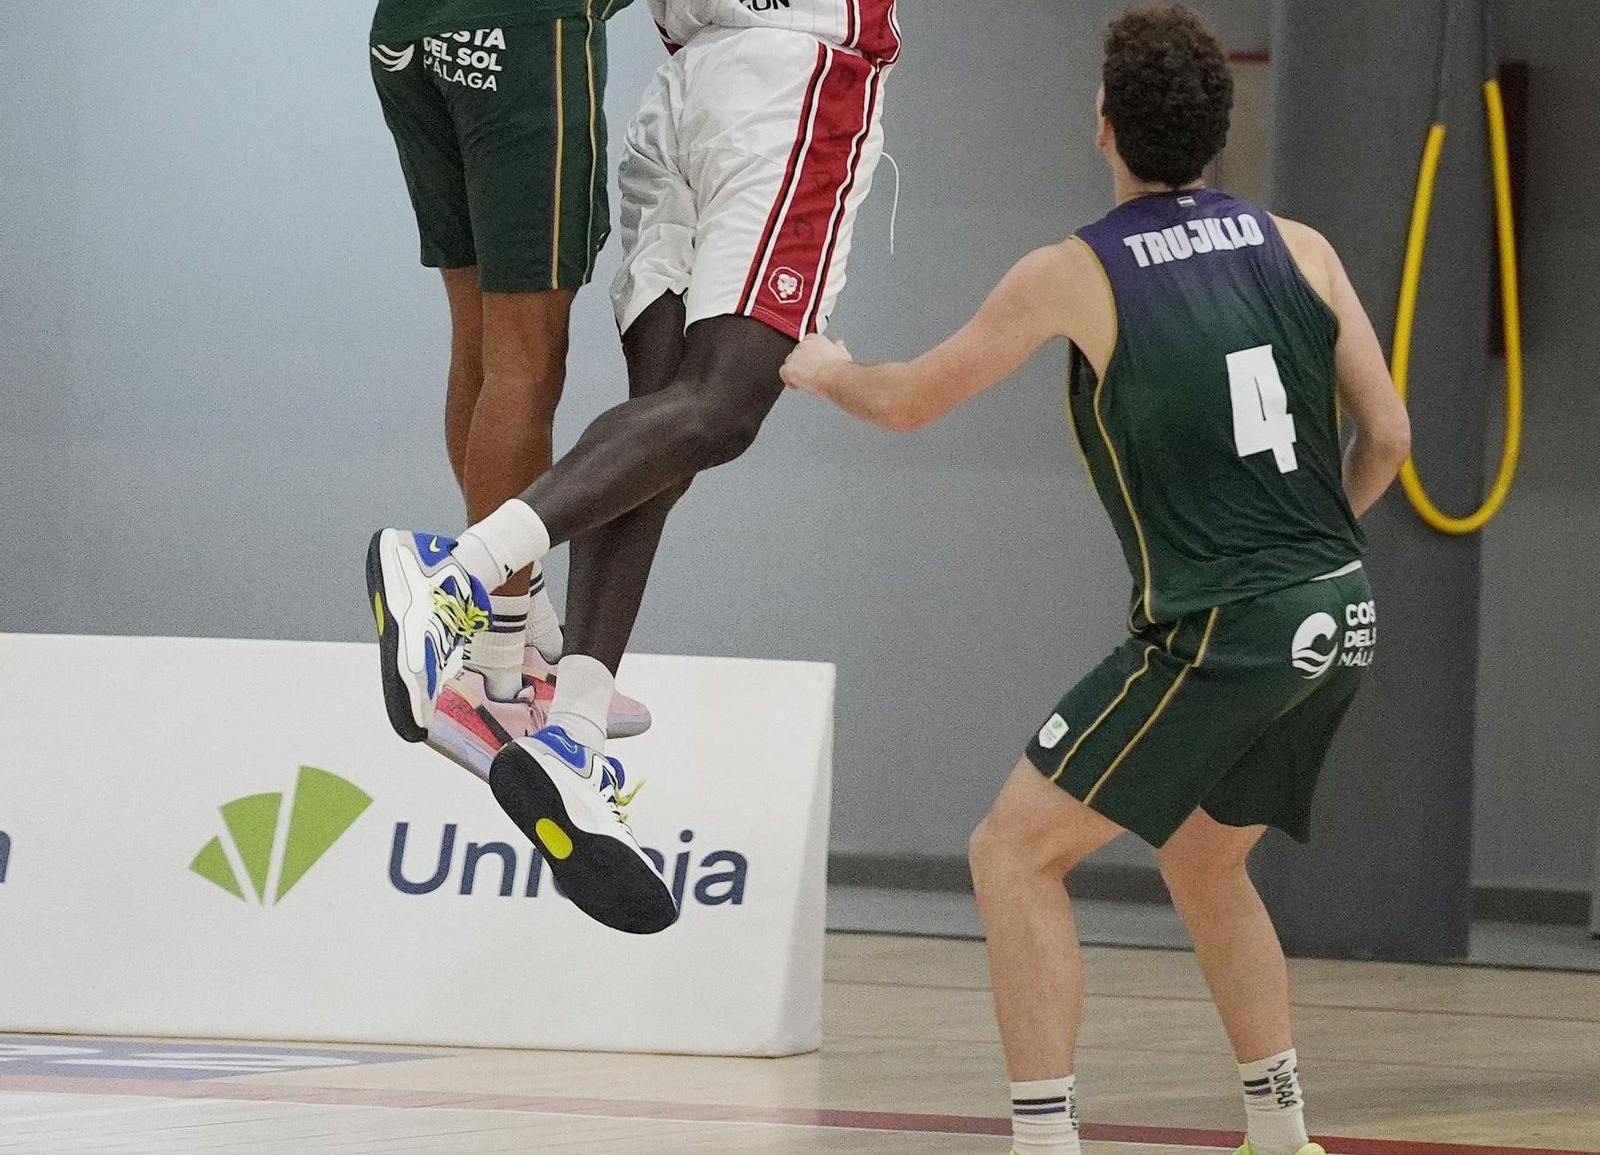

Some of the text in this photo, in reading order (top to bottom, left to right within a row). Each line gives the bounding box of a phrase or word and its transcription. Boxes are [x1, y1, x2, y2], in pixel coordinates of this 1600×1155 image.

[423, 36, 503, 72] DEL SOL
[440, 27, 507, 50] STA
[1122, 213, 1265, 268] TRUJILLO
[1226, 344, 1298, 474] 4
[387, 821, 748, 922] Unija
